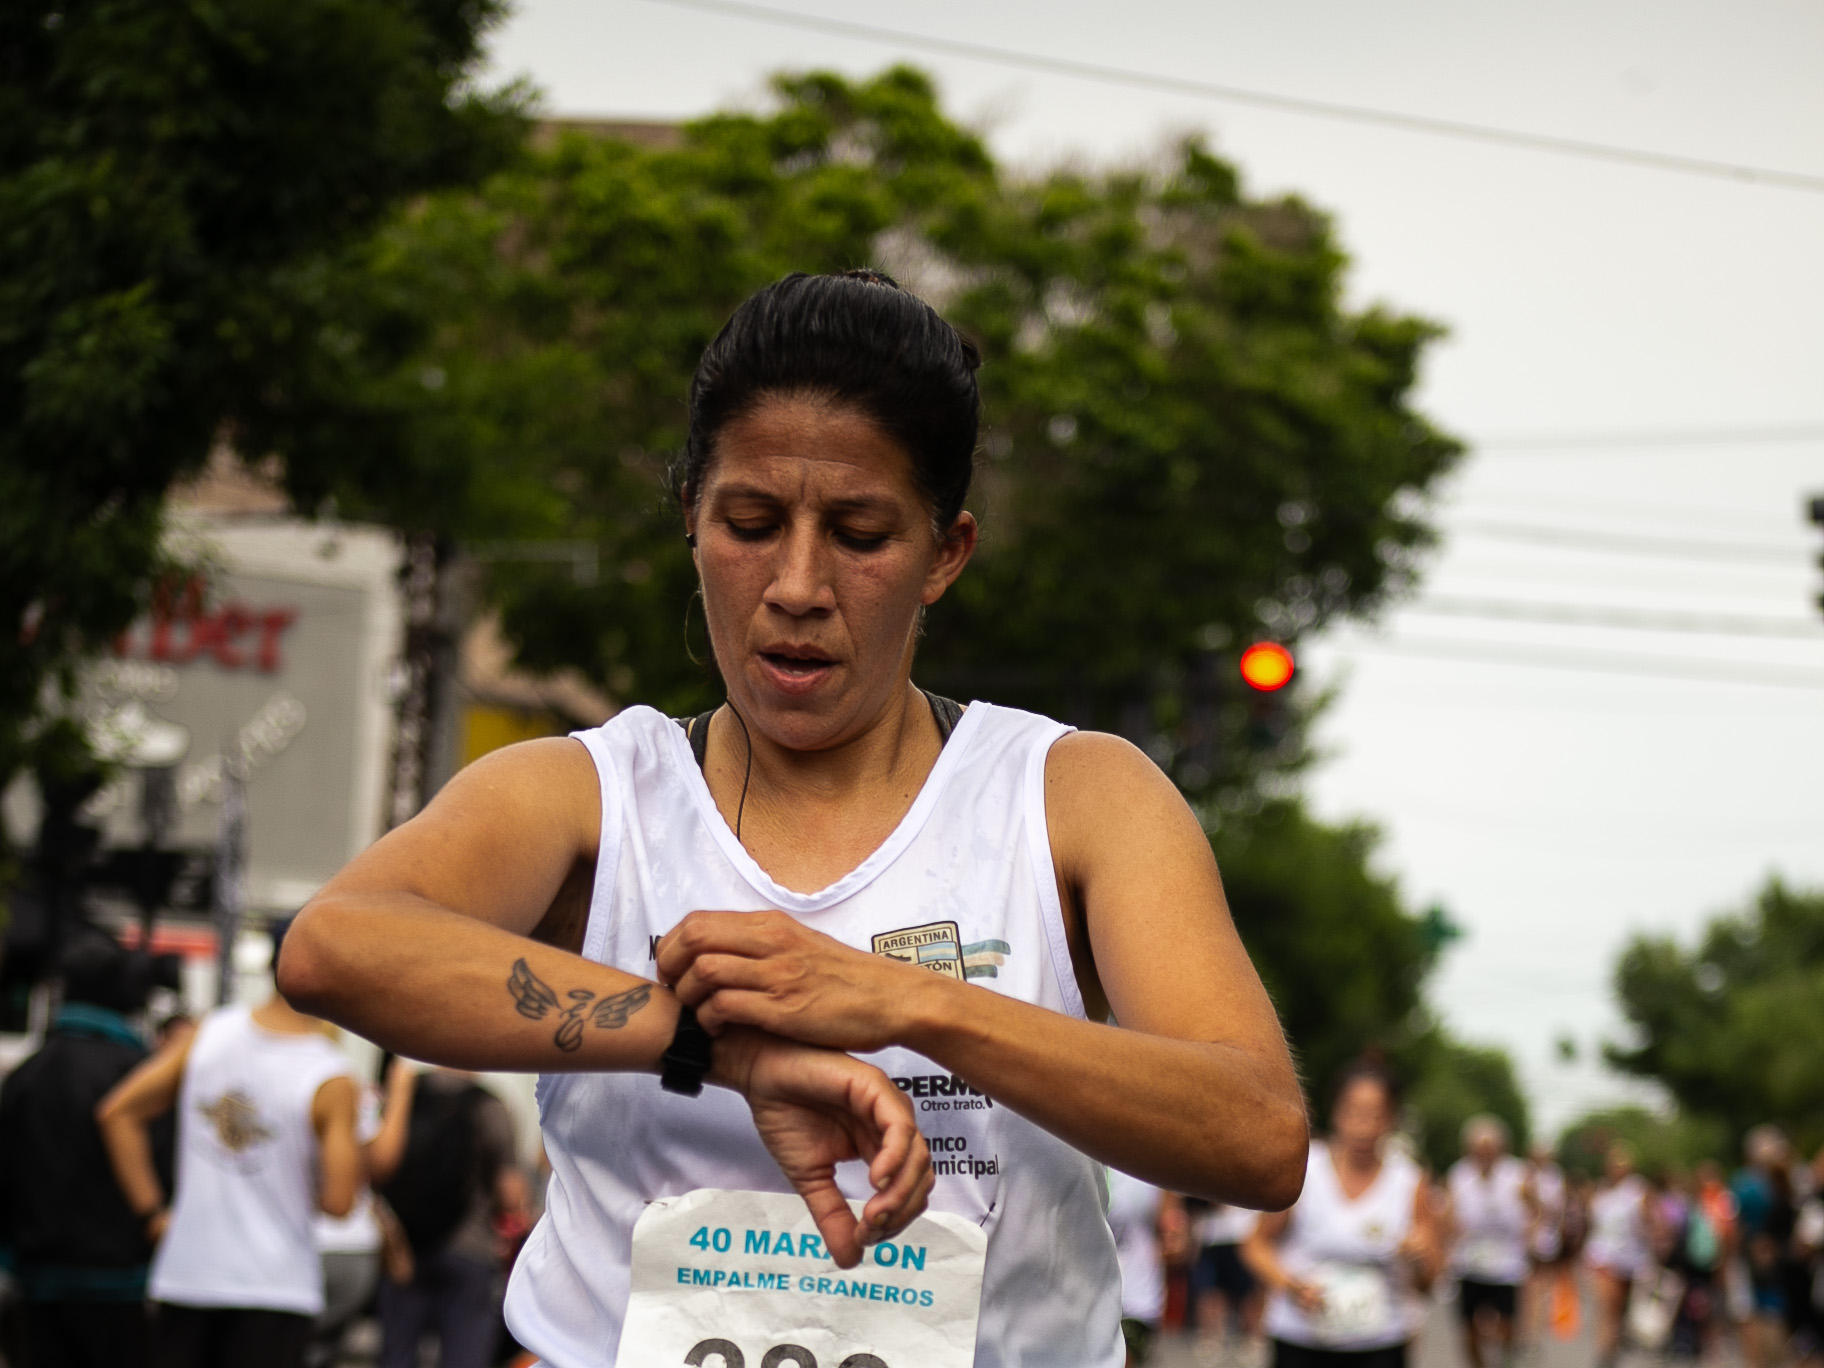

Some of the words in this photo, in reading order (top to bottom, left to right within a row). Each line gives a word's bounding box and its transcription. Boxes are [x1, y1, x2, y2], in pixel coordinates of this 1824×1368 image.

[882, 930, 950, 950] ARGENTINA
[920, 1099, 951, 1112] Otro
[953, 1099, 986, 1111] trato.
[689, 1226, 732, 1253] 40
[743, 1229, 928, 1272] MARON
[677, 1267, 791, 1291] EMPALME
[798, 1276, 935, 1308] GRANEROS
